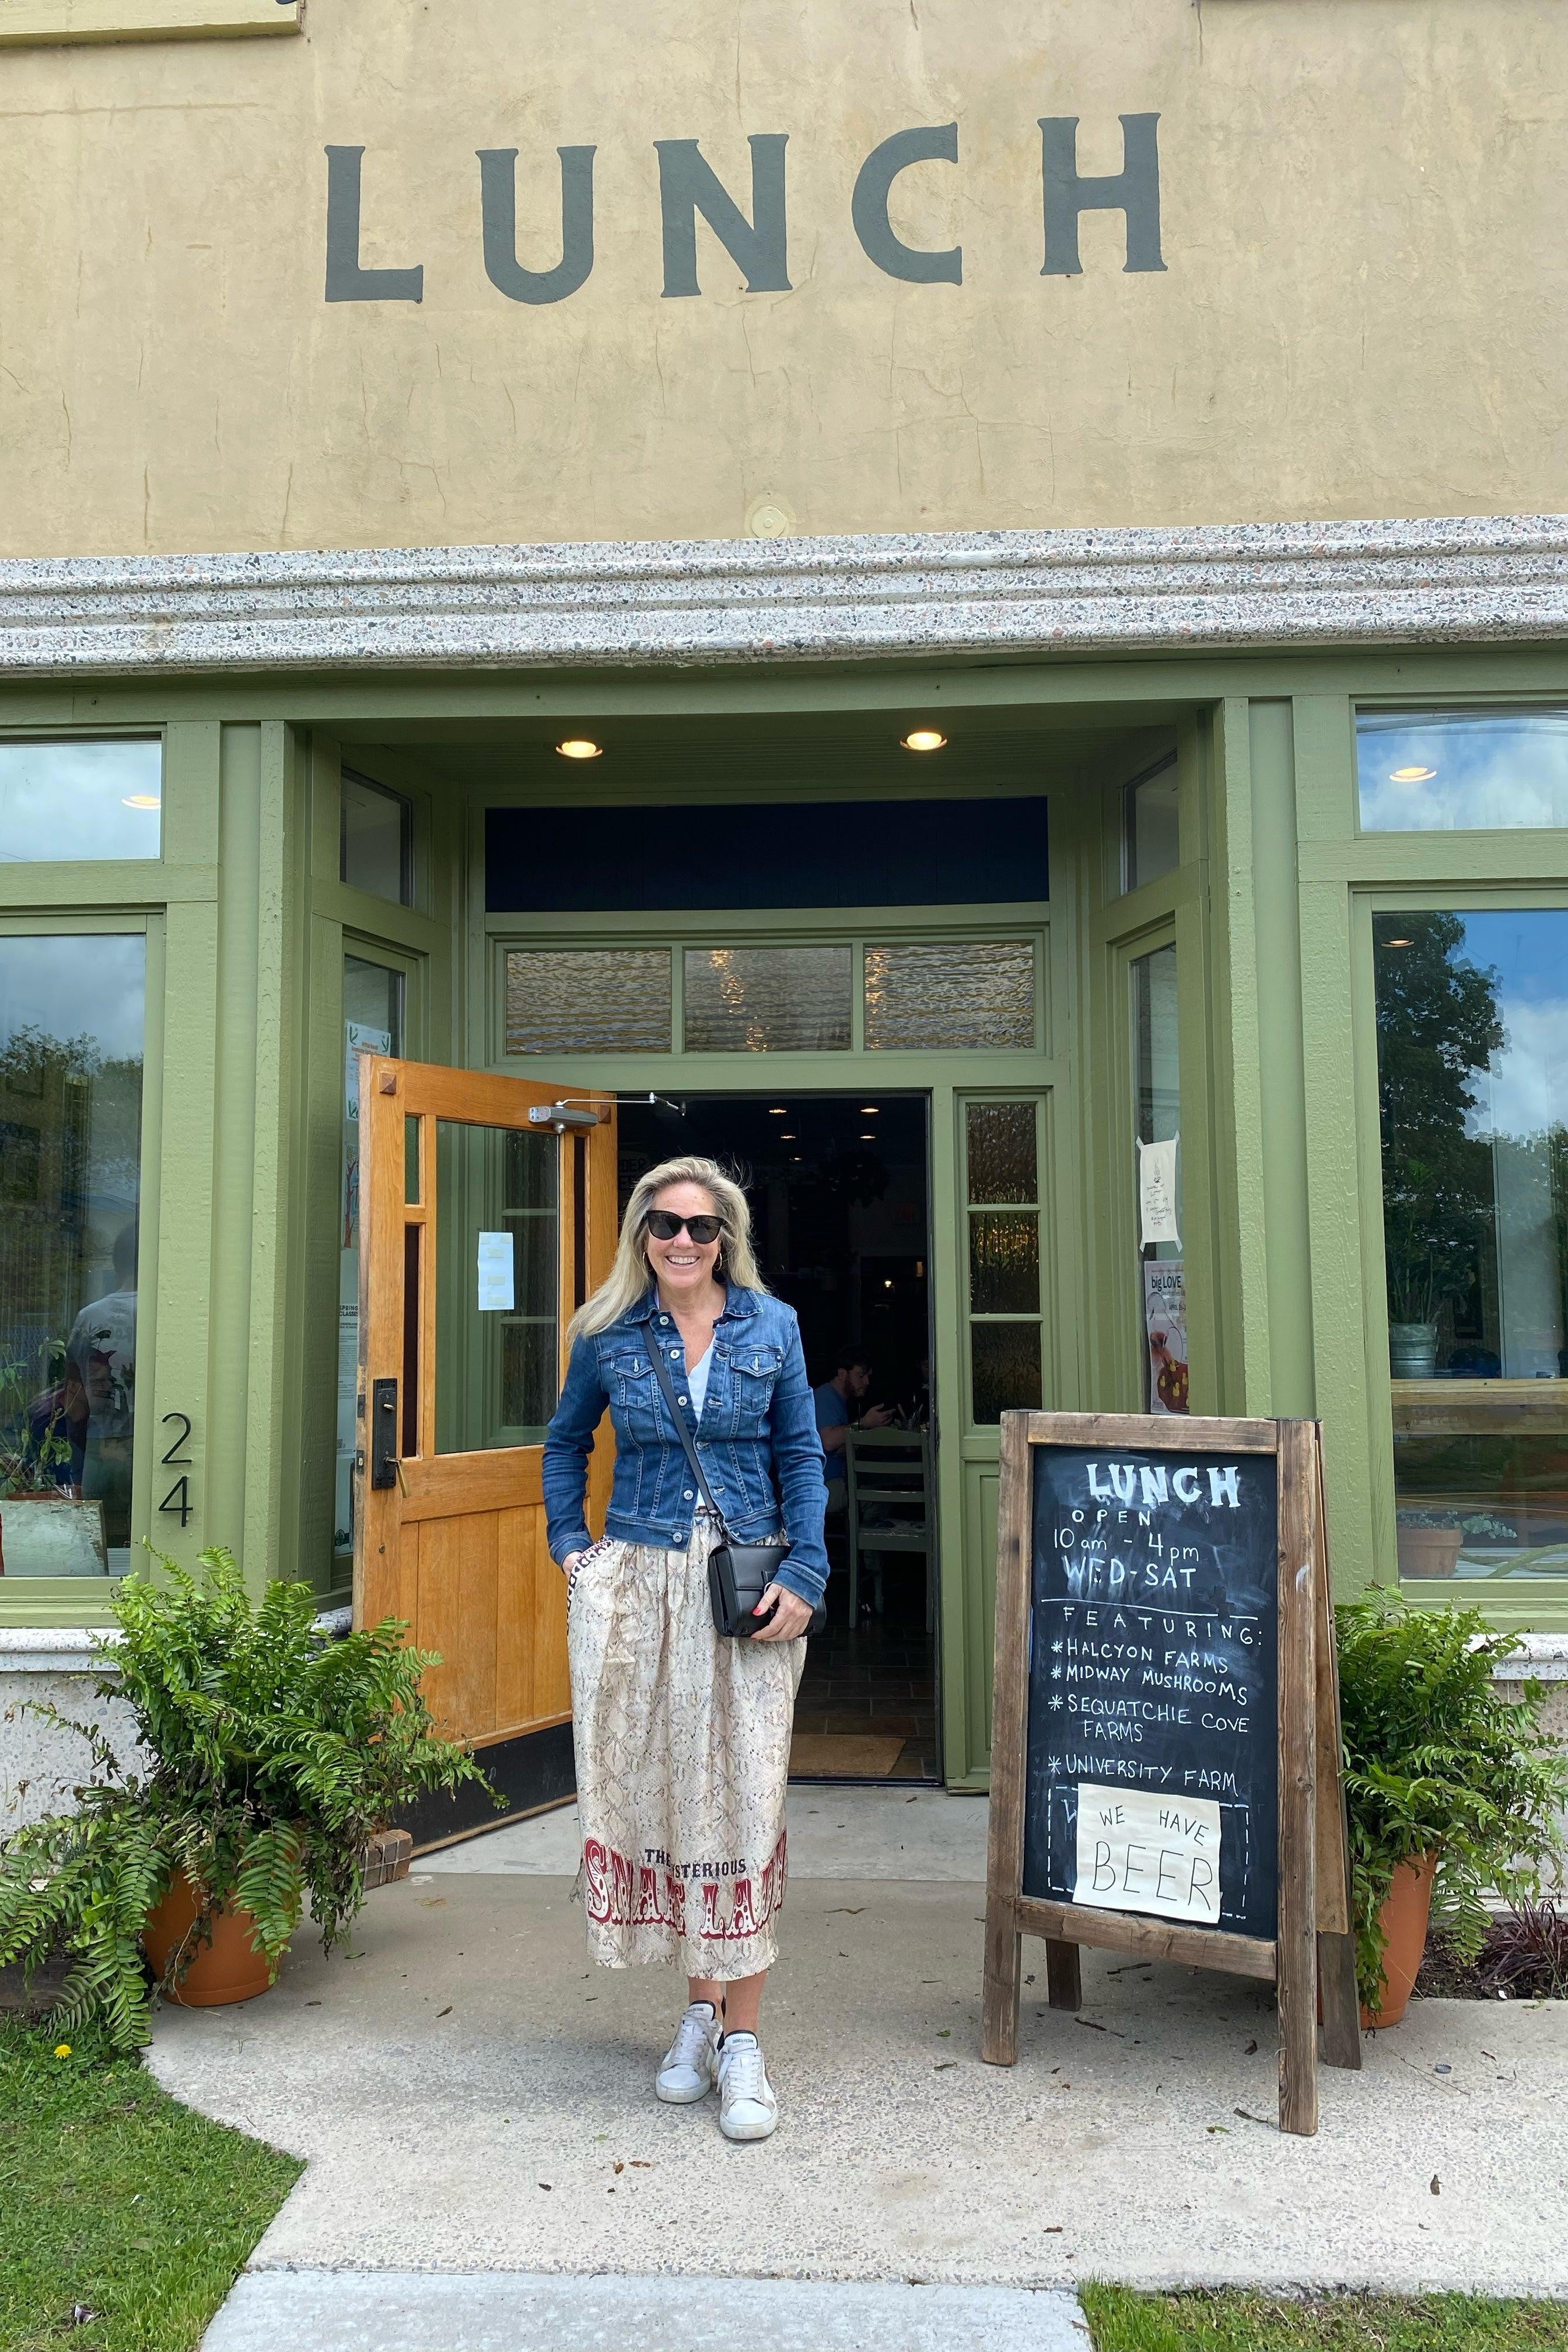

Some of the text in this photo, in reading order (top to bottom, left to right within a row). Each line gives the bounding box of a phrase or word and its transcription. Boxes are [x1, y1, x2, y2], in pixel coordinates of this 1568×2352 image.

[324, 113, 1168, 304] LUNCH
[1152, 1276, 1181, 1292] big LOVE
[1086, 1463, 1241, 1508] LUNCH
[1072, 1509, 1151, 1526] OPEN
[1063, 1606, 1262, 1646] FEATURING:
[1067, 1638, 1228, 1674] HALCYON FARMS
[1066, 1665, 1248, 1706] MIDWAY MUSHROOMS
[1068, 1693, 1250, 1733] SEQUATCHIE COVE
[1084, 1719, 1144, 1743] FARMS
[1065, 1754, 1238, 1797] UNIVERSITY FARM
[1099, 1805, 1125, 1826] WE
[1159, 1810, 1209, 1846] HAVE
[645, 1848, 671, 1867] THE
[673, 1859, 747, 1878] STERIOUS
[1092, 1840, 1213, 1911] BEER
